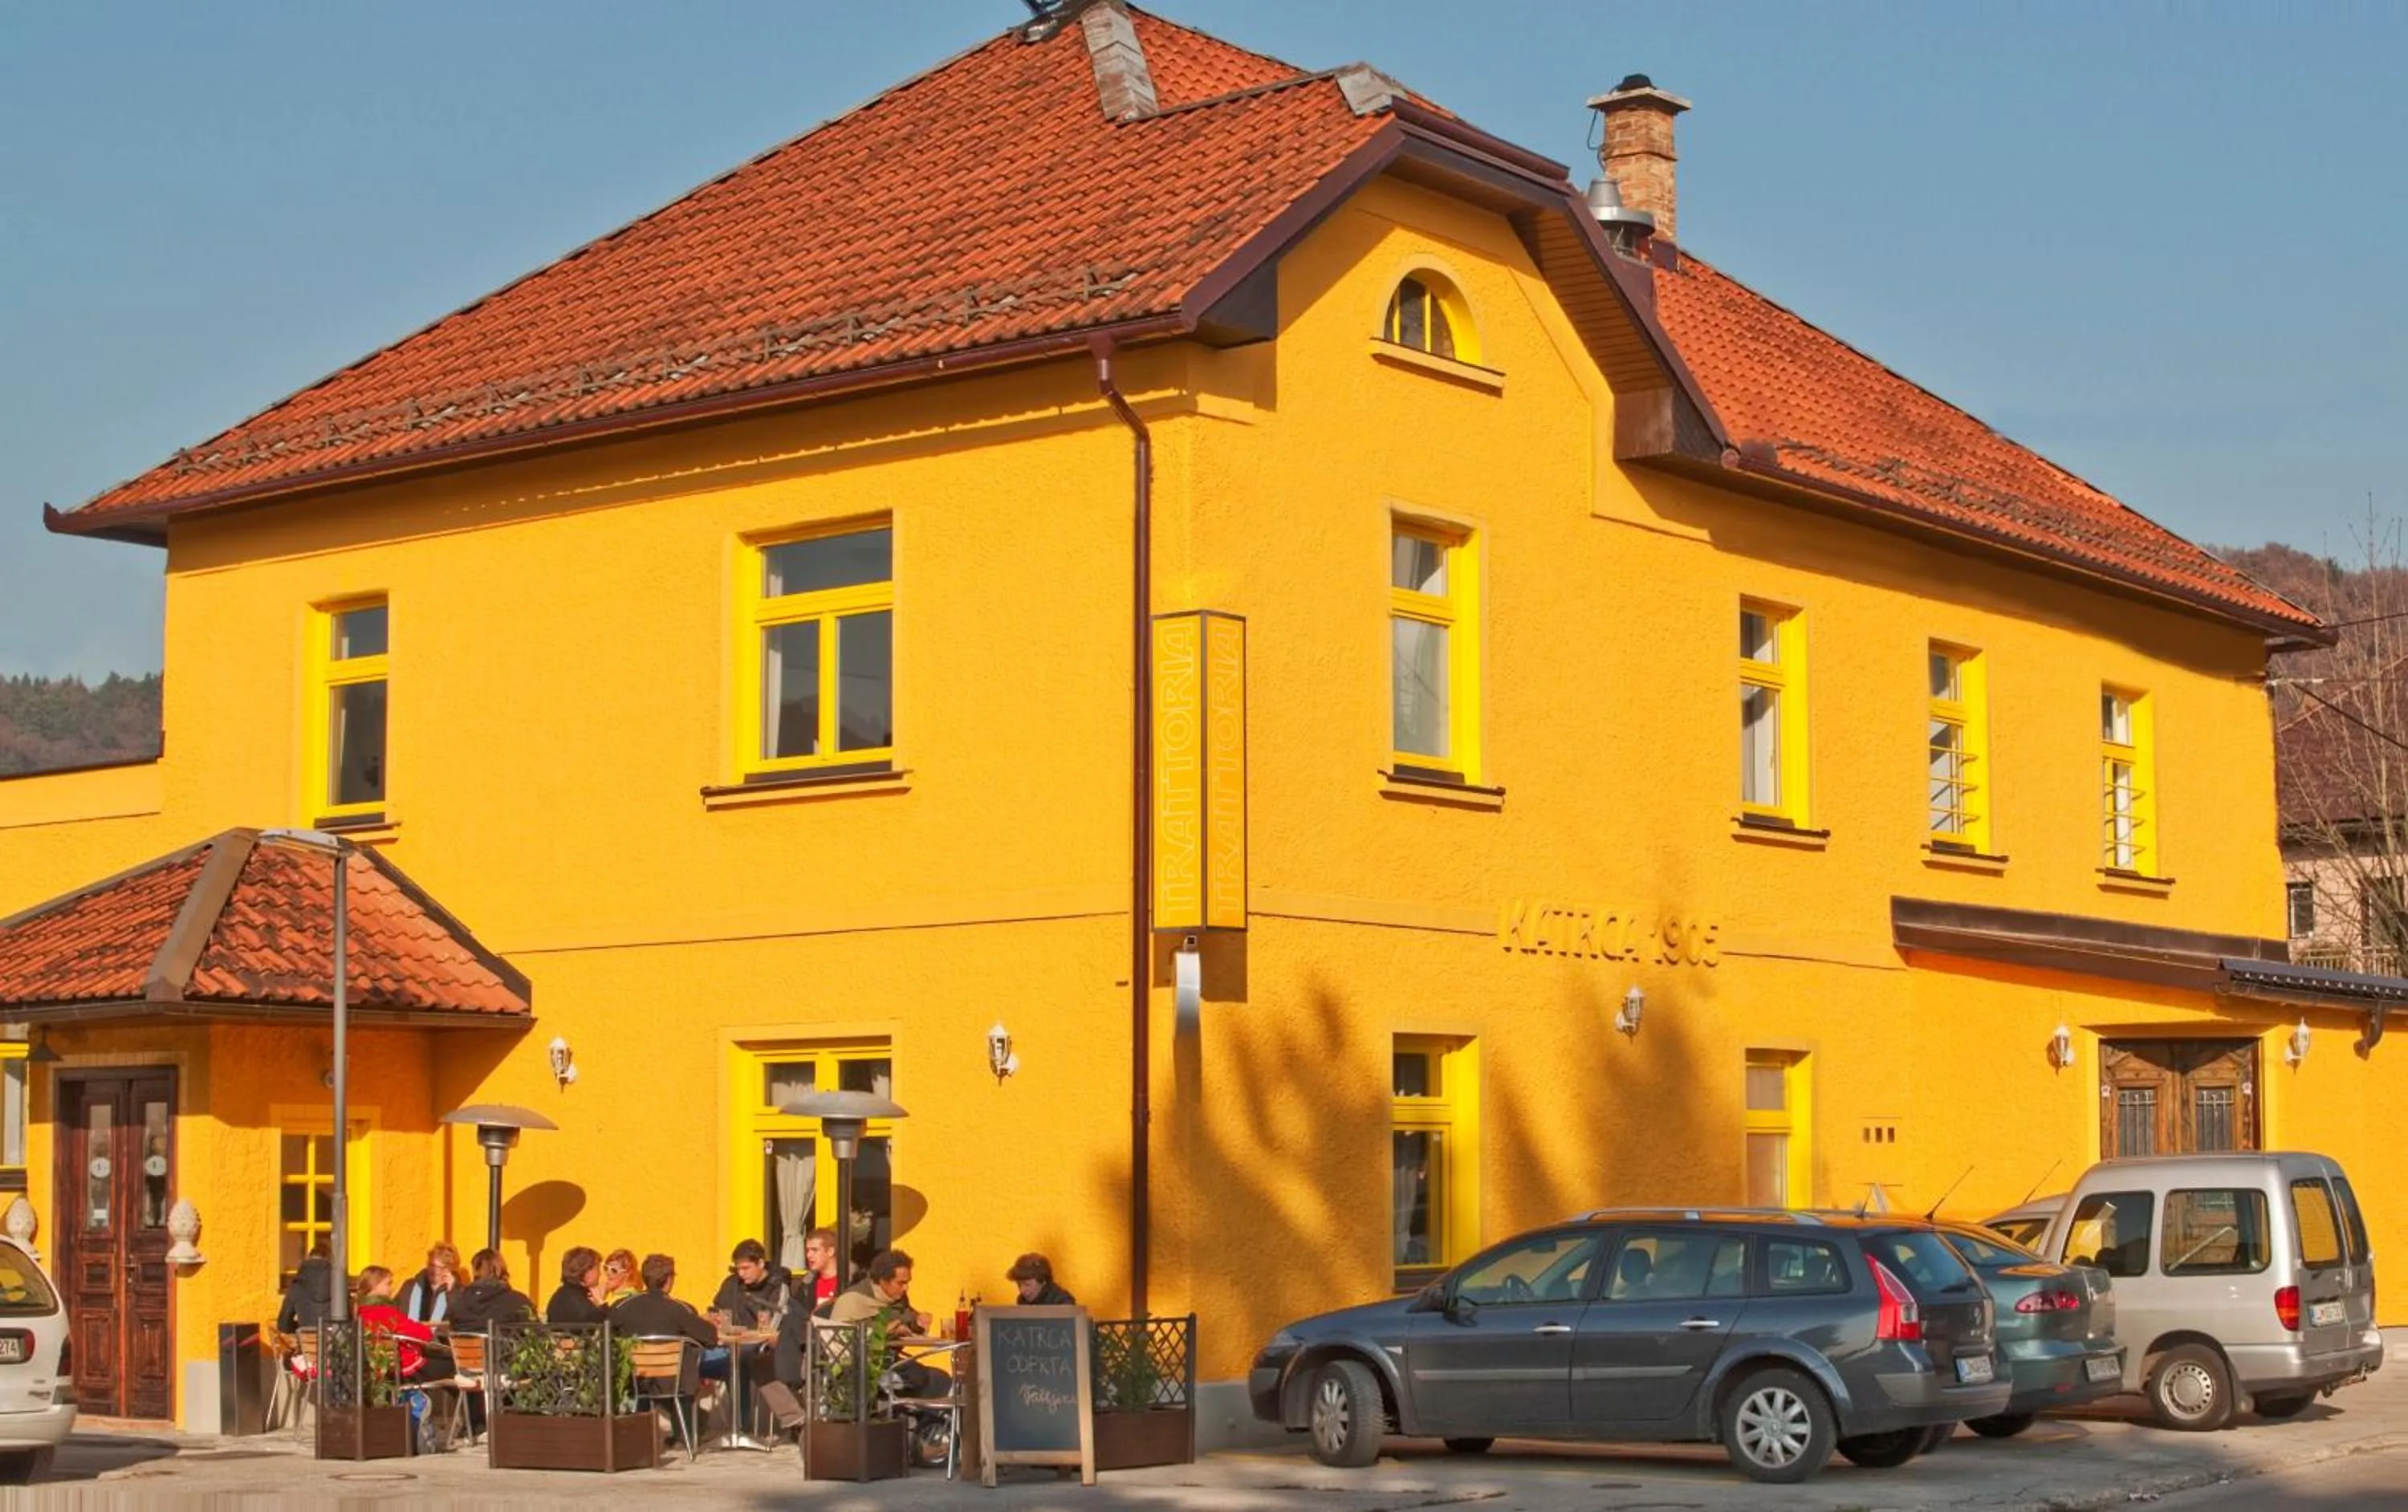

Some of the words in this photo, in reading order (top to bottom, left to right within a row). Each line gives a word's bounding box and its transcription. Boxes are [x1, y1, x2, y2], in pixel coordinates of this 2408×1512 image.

[1161, 621, 1194, 918] TRATTORIA
[1213, 622, 1239, 921] TRATTORIA
[1498, 899, 1641, 963] KATRCA
[996, 1324, 1073, 1350] KATRCA
